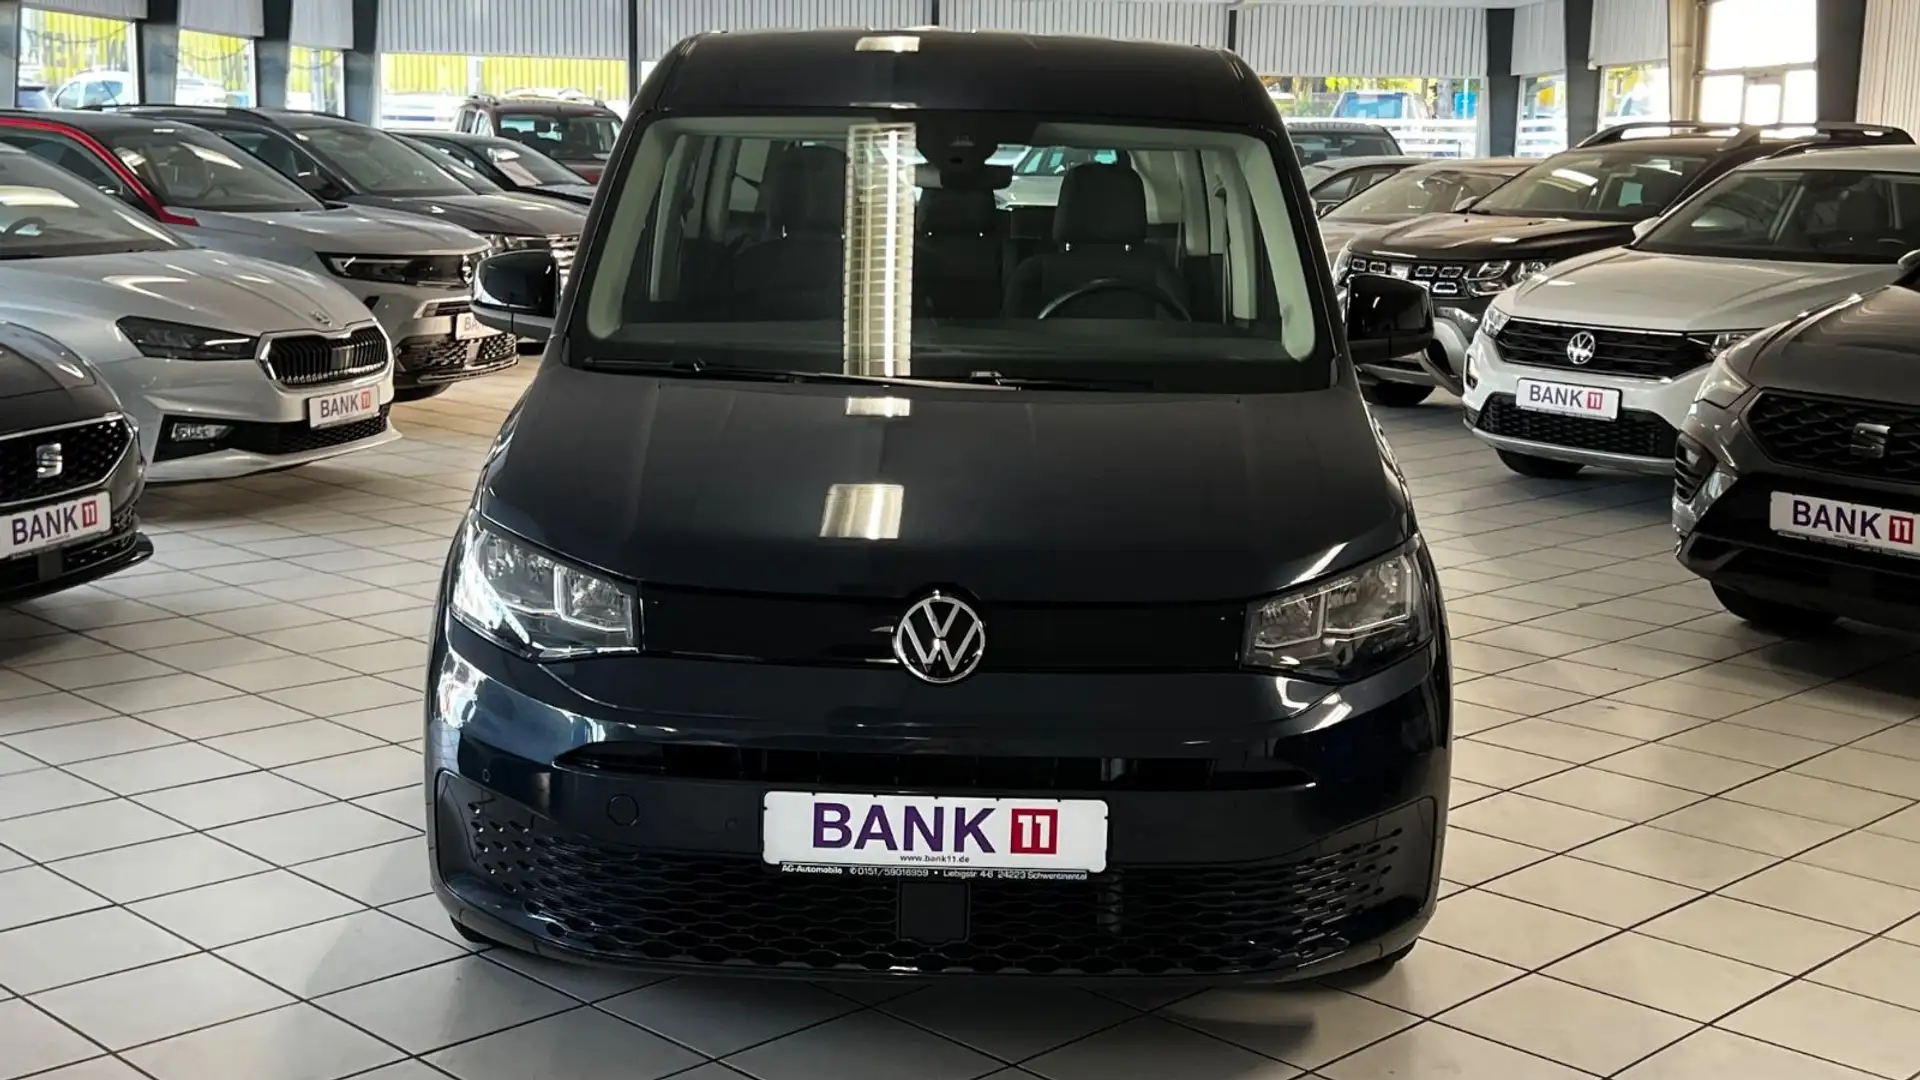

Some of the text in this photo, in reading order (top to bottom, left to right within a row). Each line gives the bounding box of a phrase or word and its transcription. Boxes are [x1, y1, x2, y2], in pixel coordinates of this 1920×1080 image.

[320, 394, 359, 418] BANK
[1529, 384, 1602, 408] BANK 11
[12, 501, 97, 545] BANK 11
[1792, 500, 1912, 543] BANK 11
[812, 802, 1055, 854] BANK 11
[781, 864, 843, 875] AG-Automobile
[900, 855, 970, 863] www.bank11.de
